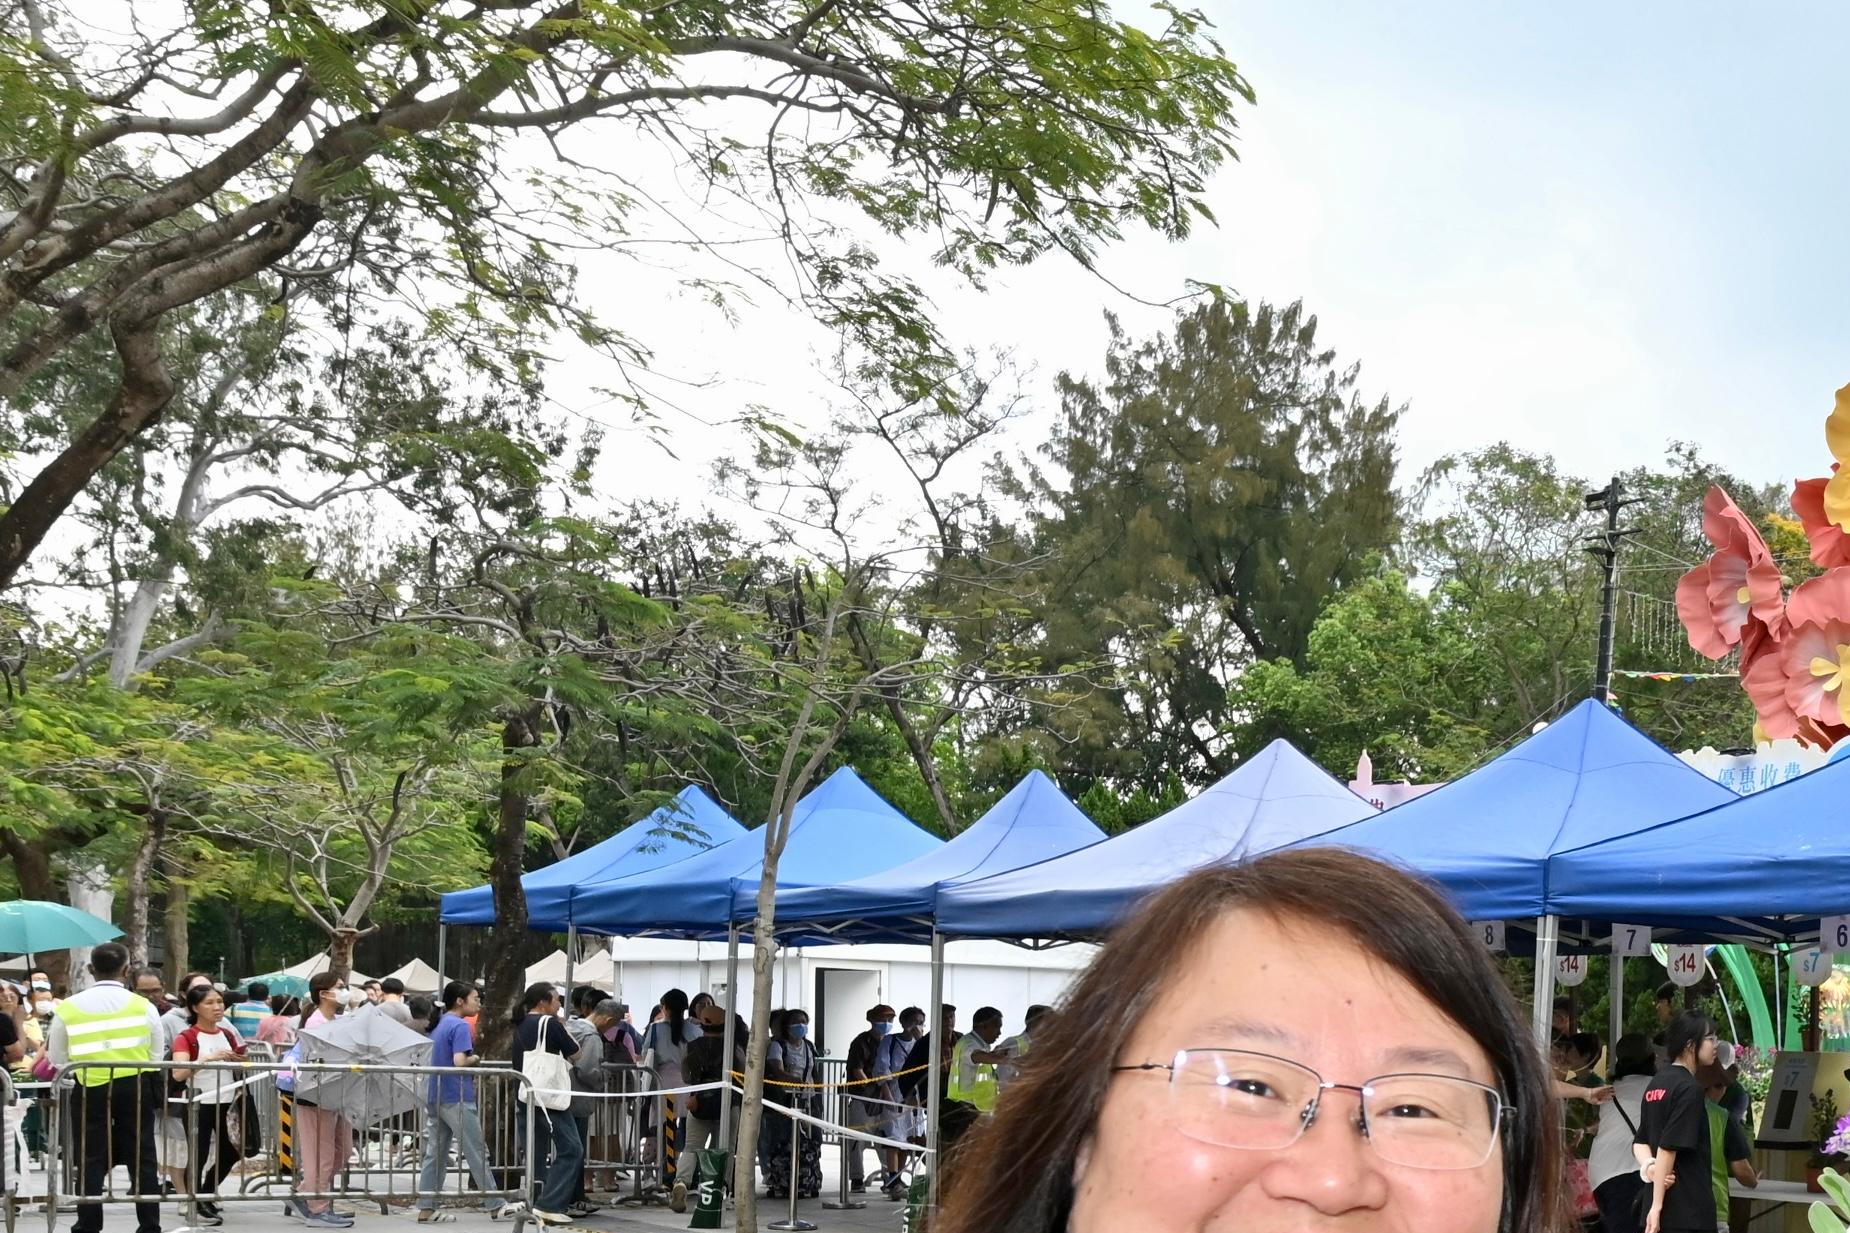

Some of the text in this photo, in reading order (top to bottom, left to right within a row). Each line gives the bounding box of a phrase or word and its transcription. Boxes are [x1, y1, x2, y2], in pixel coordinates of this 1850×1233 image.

[1485, 924, 1494, 945] 8
[1626, 929, 1637, 950] 7
[1836, 924, 1848, 948] 6
[1674, 952, 1697, 973] $14
[1803, 952, 1820, 973] $7
